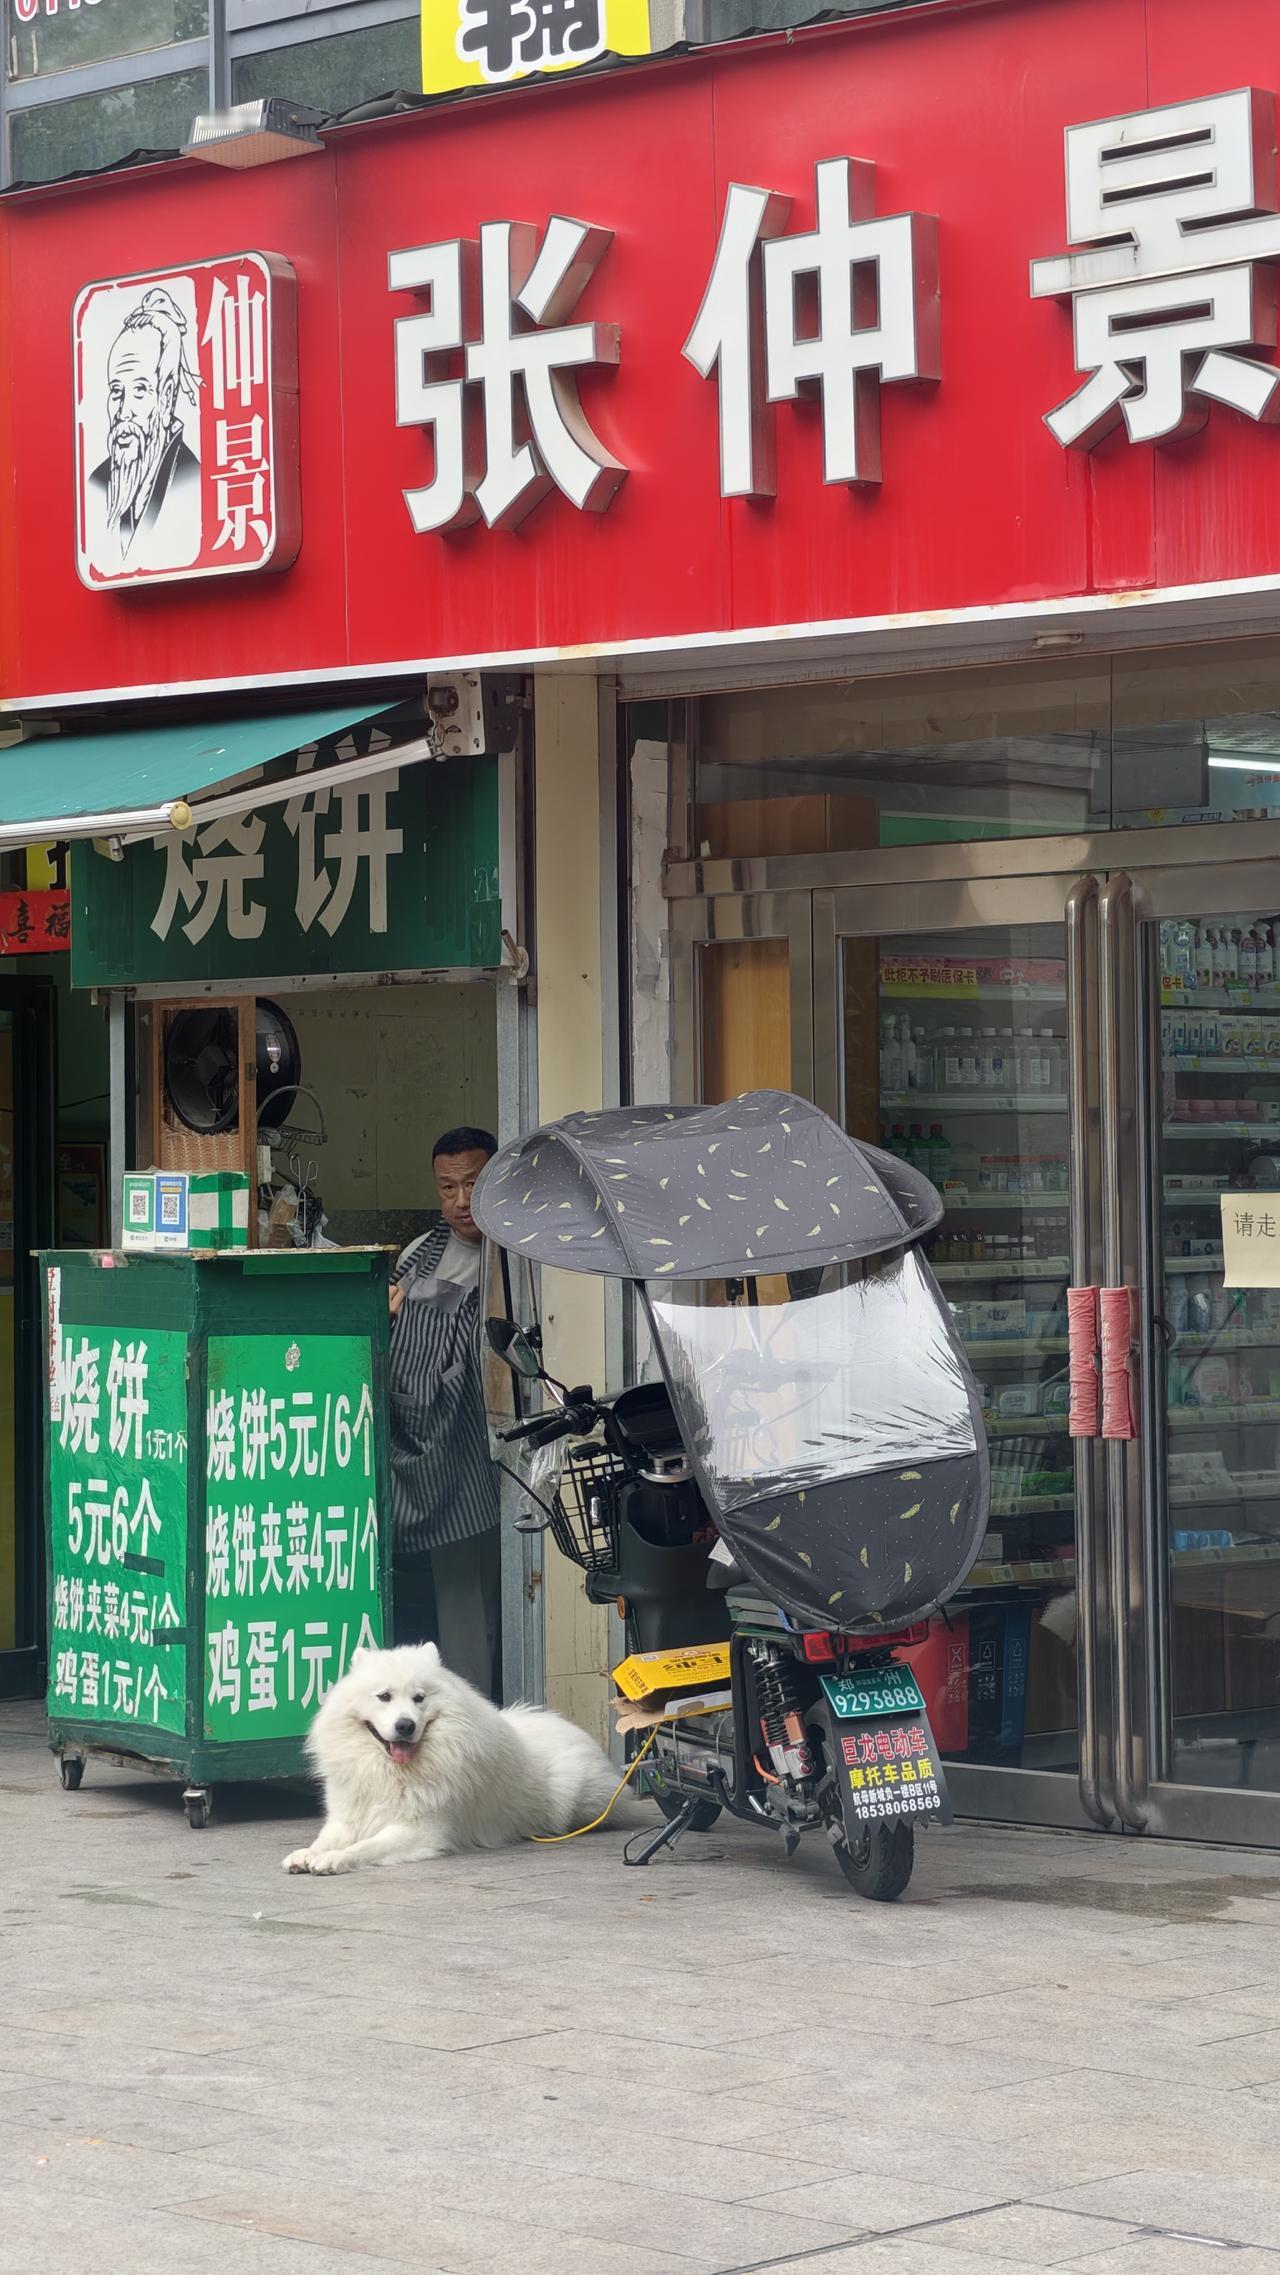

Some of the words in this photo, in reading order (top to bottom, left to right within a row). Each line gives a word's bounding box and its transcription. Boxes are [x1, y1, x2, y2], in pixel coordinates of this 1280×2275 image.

[387, 87, 1280, 535] 张仲景
[201, 273, 270, 551] 仲景
[150, 728, 403, 945] 烧饼
[1233, 1211, 1277, 1238] 请走
[57, 1336, 149, 1460] 烧饼
[146, 1429, 188, 1464] 1元1个
[206, 1382, 374, 1482] 烧饼5元/6个
[68, 1477, 162, 1575] 5元6个
[205, 1497, 379, 1599] 烧饼夹菜4元/个
[54, 1574, 180, 1652] 烧饼夹菜4元/个
[55, 1647, 168, 1723] 鸡蛋1元/个
[834, 1686, 919, 1713] 9293888
[841, 1727, 929, 1765] 巨龙电动车
[849, 1757, 935, 1789] 摩托车品质
[855, 1795, 941, 1820] 18538068569
